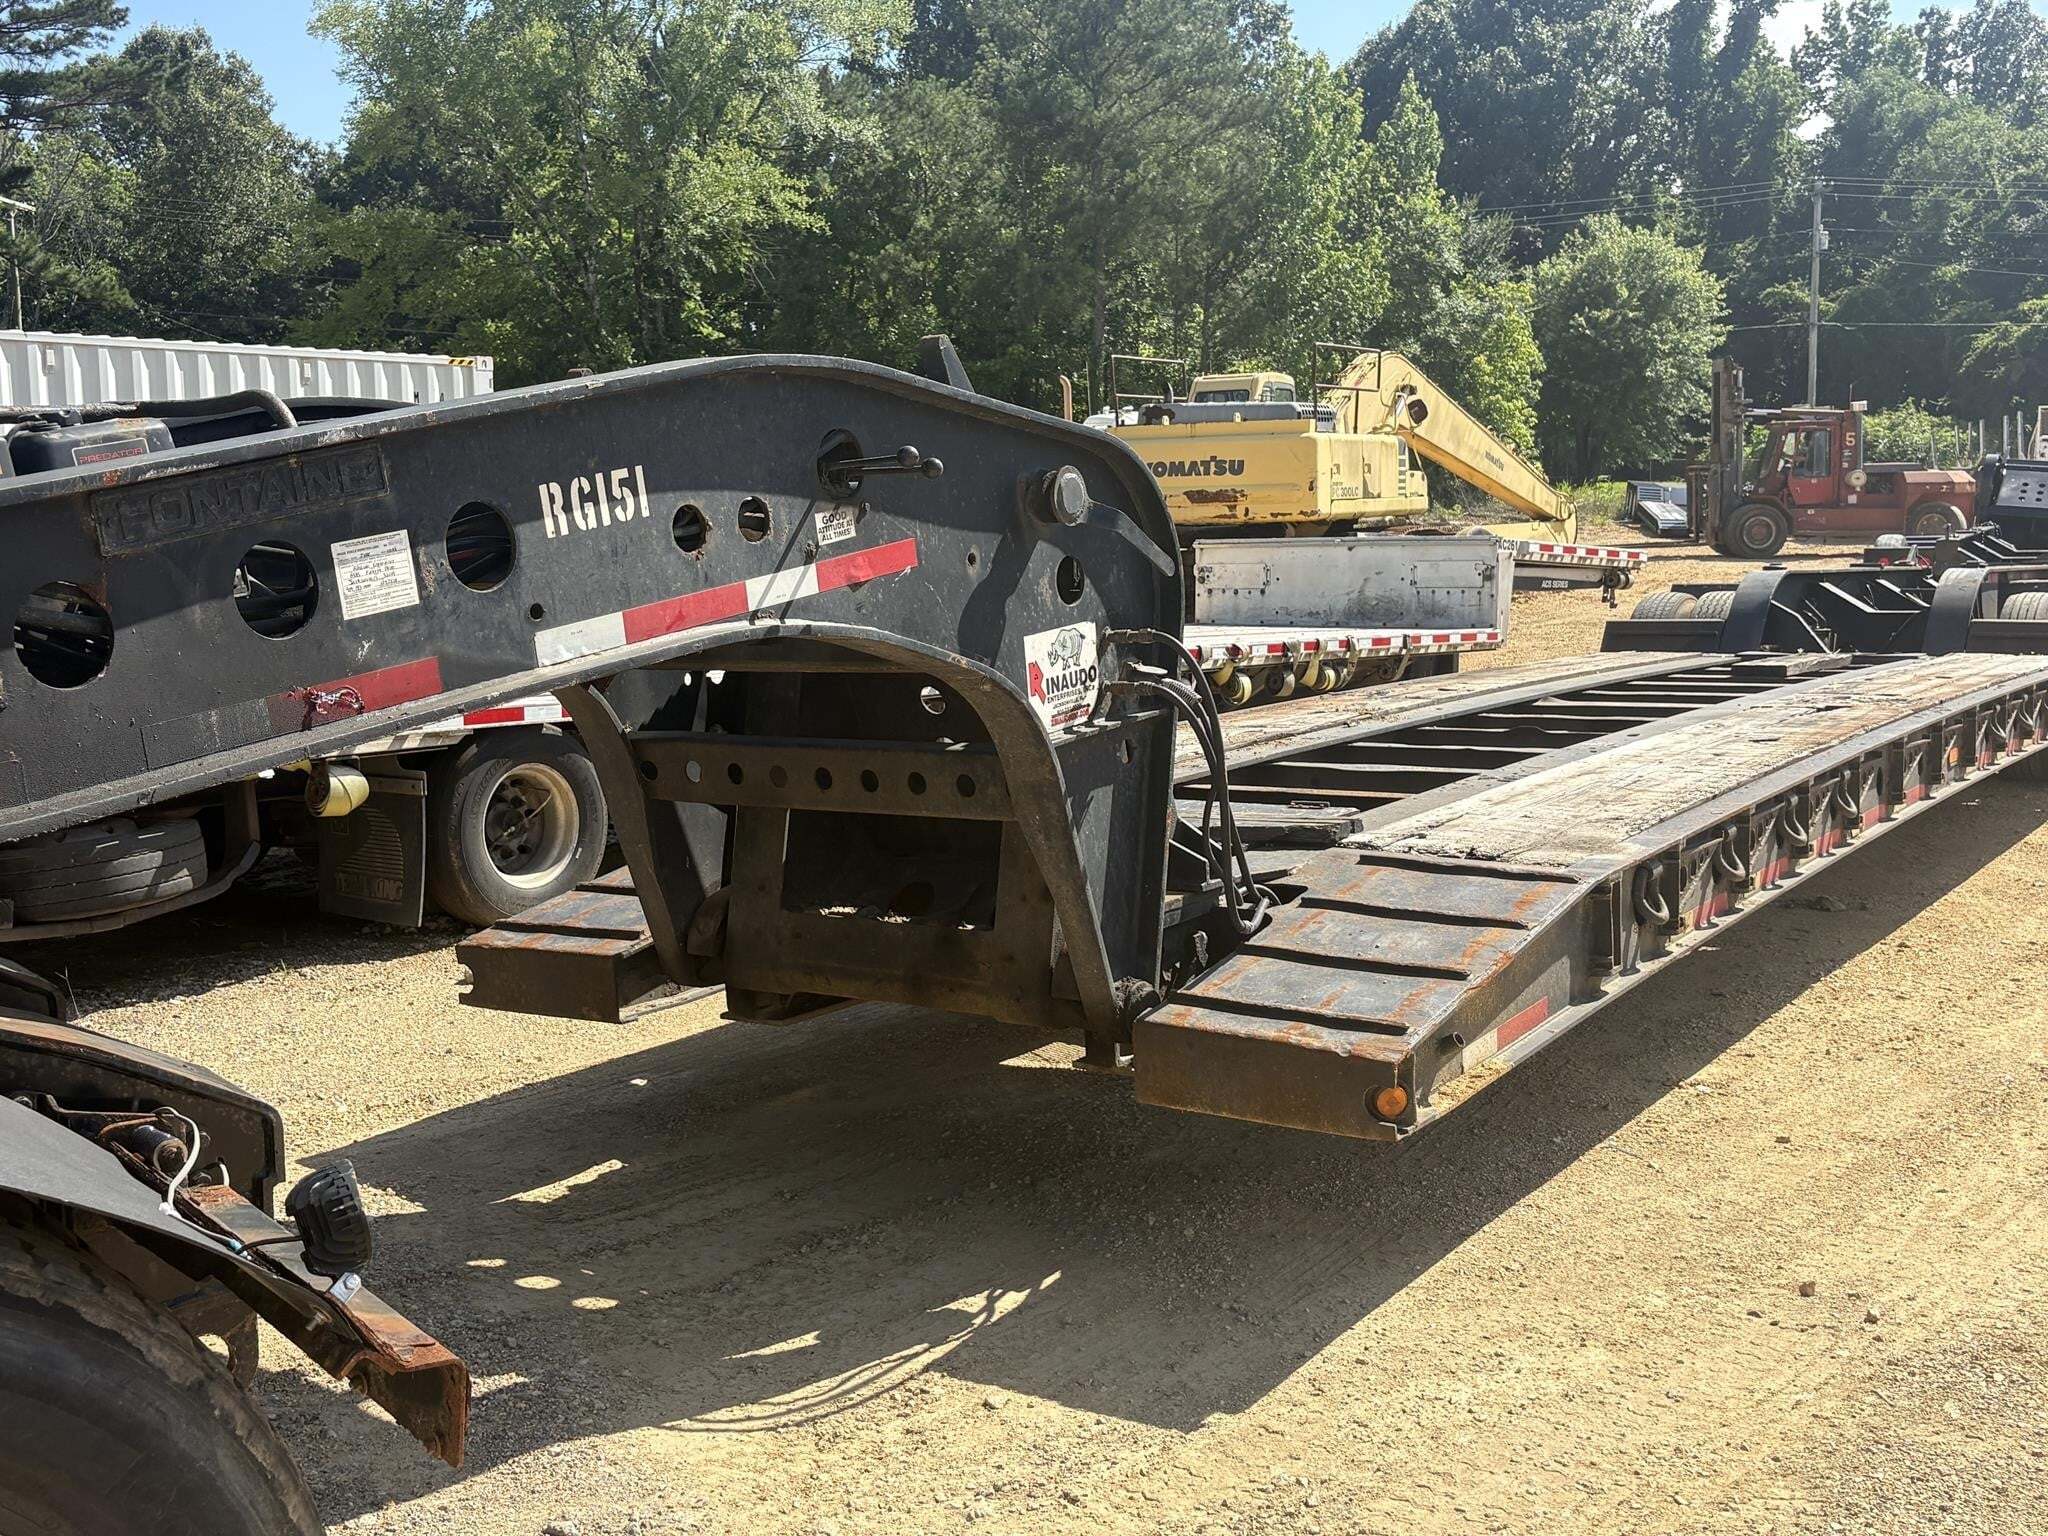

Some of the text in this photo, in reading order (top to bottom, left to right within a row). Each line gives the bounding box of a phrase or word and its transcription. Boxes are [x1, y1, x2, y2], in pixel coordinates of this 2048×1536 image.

[1845, 432, 1856, 446] 5
[79, 447, 144, 465] PREDATOR
[822, 511, 847, 524] GOOD
[818, 519, 853, 534] ATTITUDE AT
[822, 534, 833, 542] ALL
